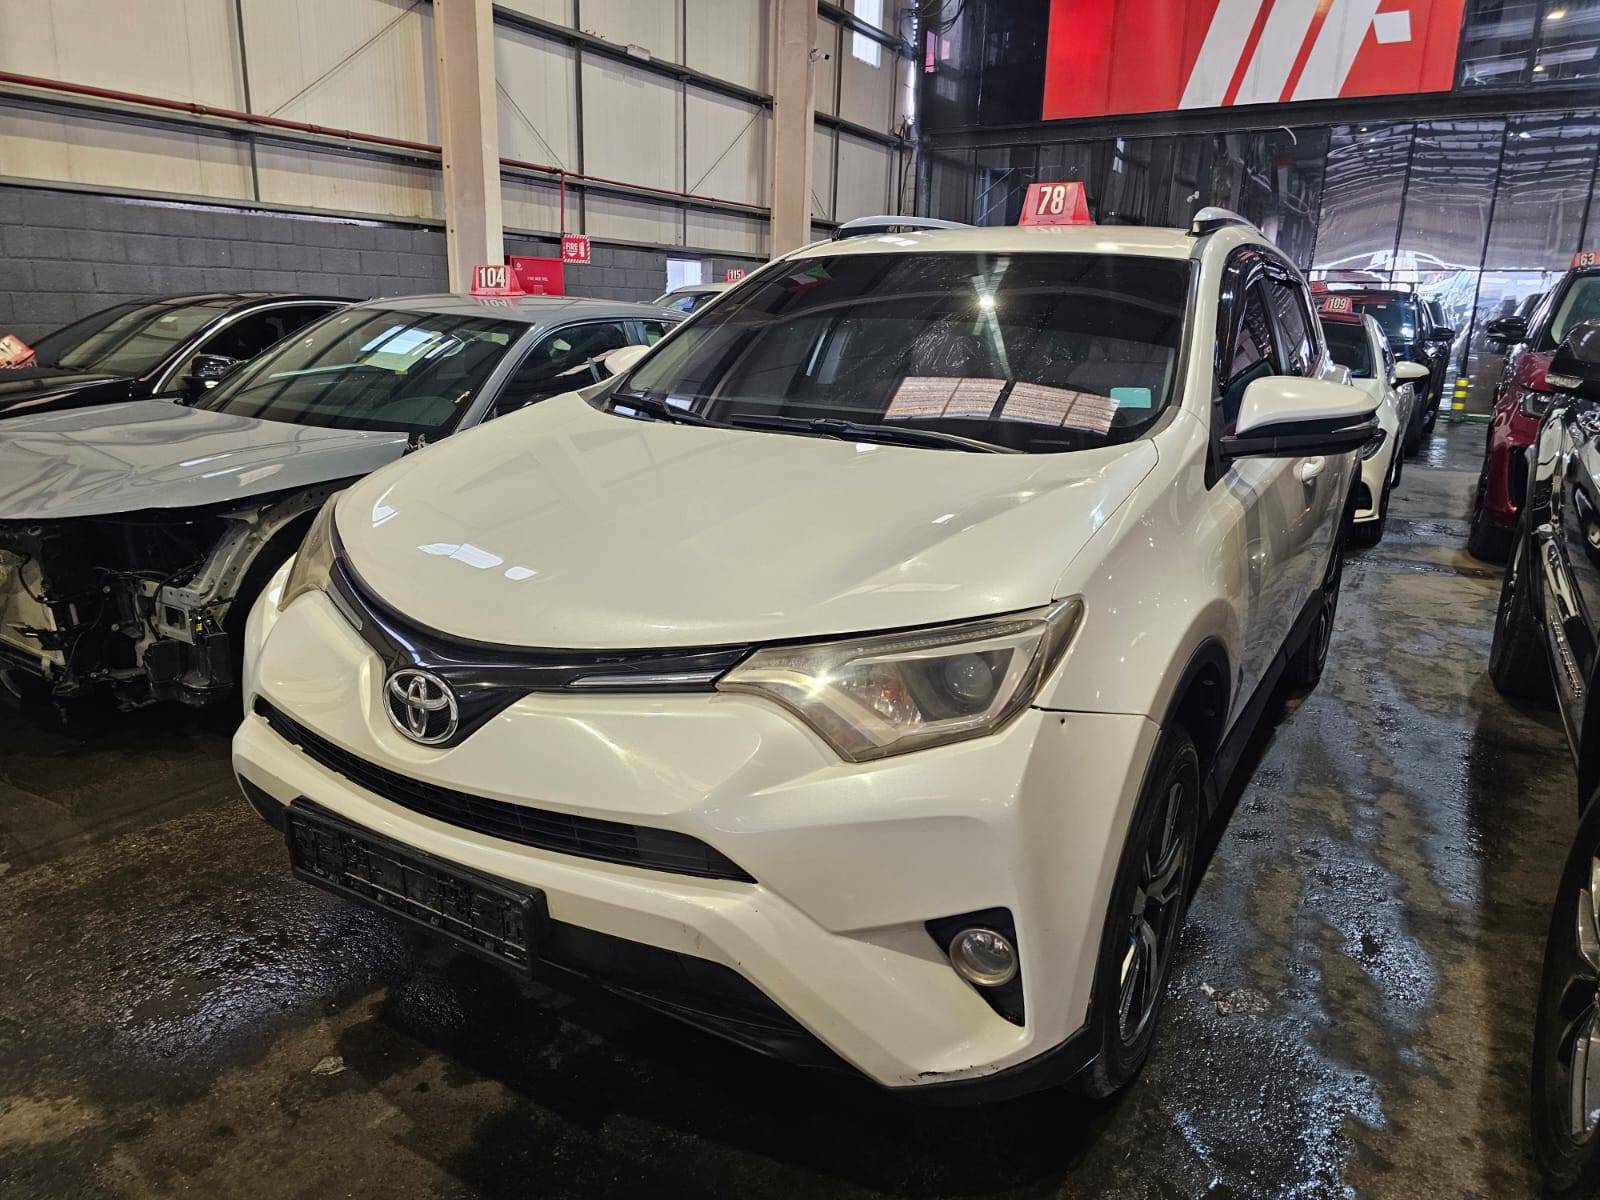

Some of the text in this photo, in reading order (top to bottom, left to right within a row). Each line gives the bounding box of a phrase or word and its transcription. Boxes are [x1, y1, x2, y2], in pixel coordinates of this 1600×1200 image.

[1037, 185, 1066, 215] 78
[479, 267, 506, 288] 104
[729, 269, 742, 280] 115
[1329, 297, 1347, 310] 109
